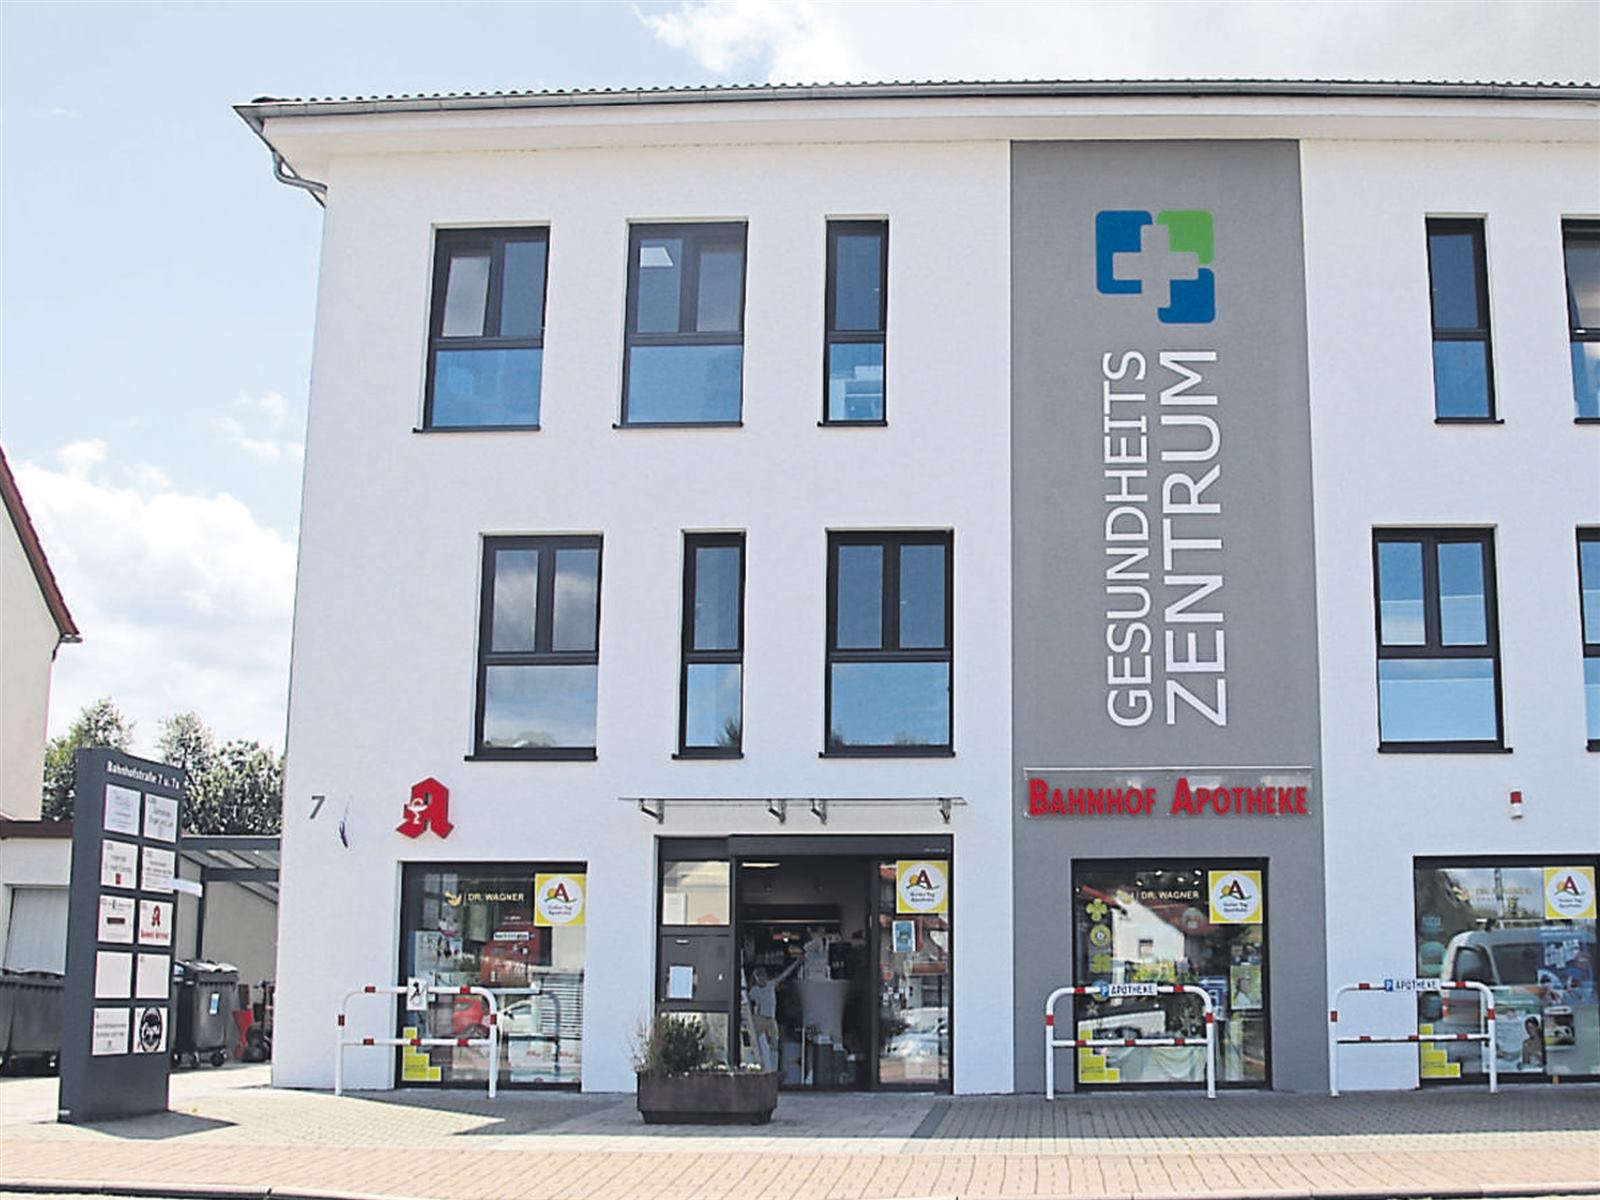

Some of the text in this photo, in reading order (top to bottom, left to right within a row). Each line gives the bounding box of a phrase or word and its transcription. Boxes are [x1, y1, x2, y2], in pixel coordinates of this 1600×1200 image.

[1102, 350, 1154, 727] GESUNDHEITS
[1159, 350, 1228, 727] ZENTRUM
[309, 795, 326, 819] 7
[485, 892, 525, 902] WAGNER
[1158, 890, 1200, 900] WAGNER
[1395, 979, 1438, 990] APOTHEKE
